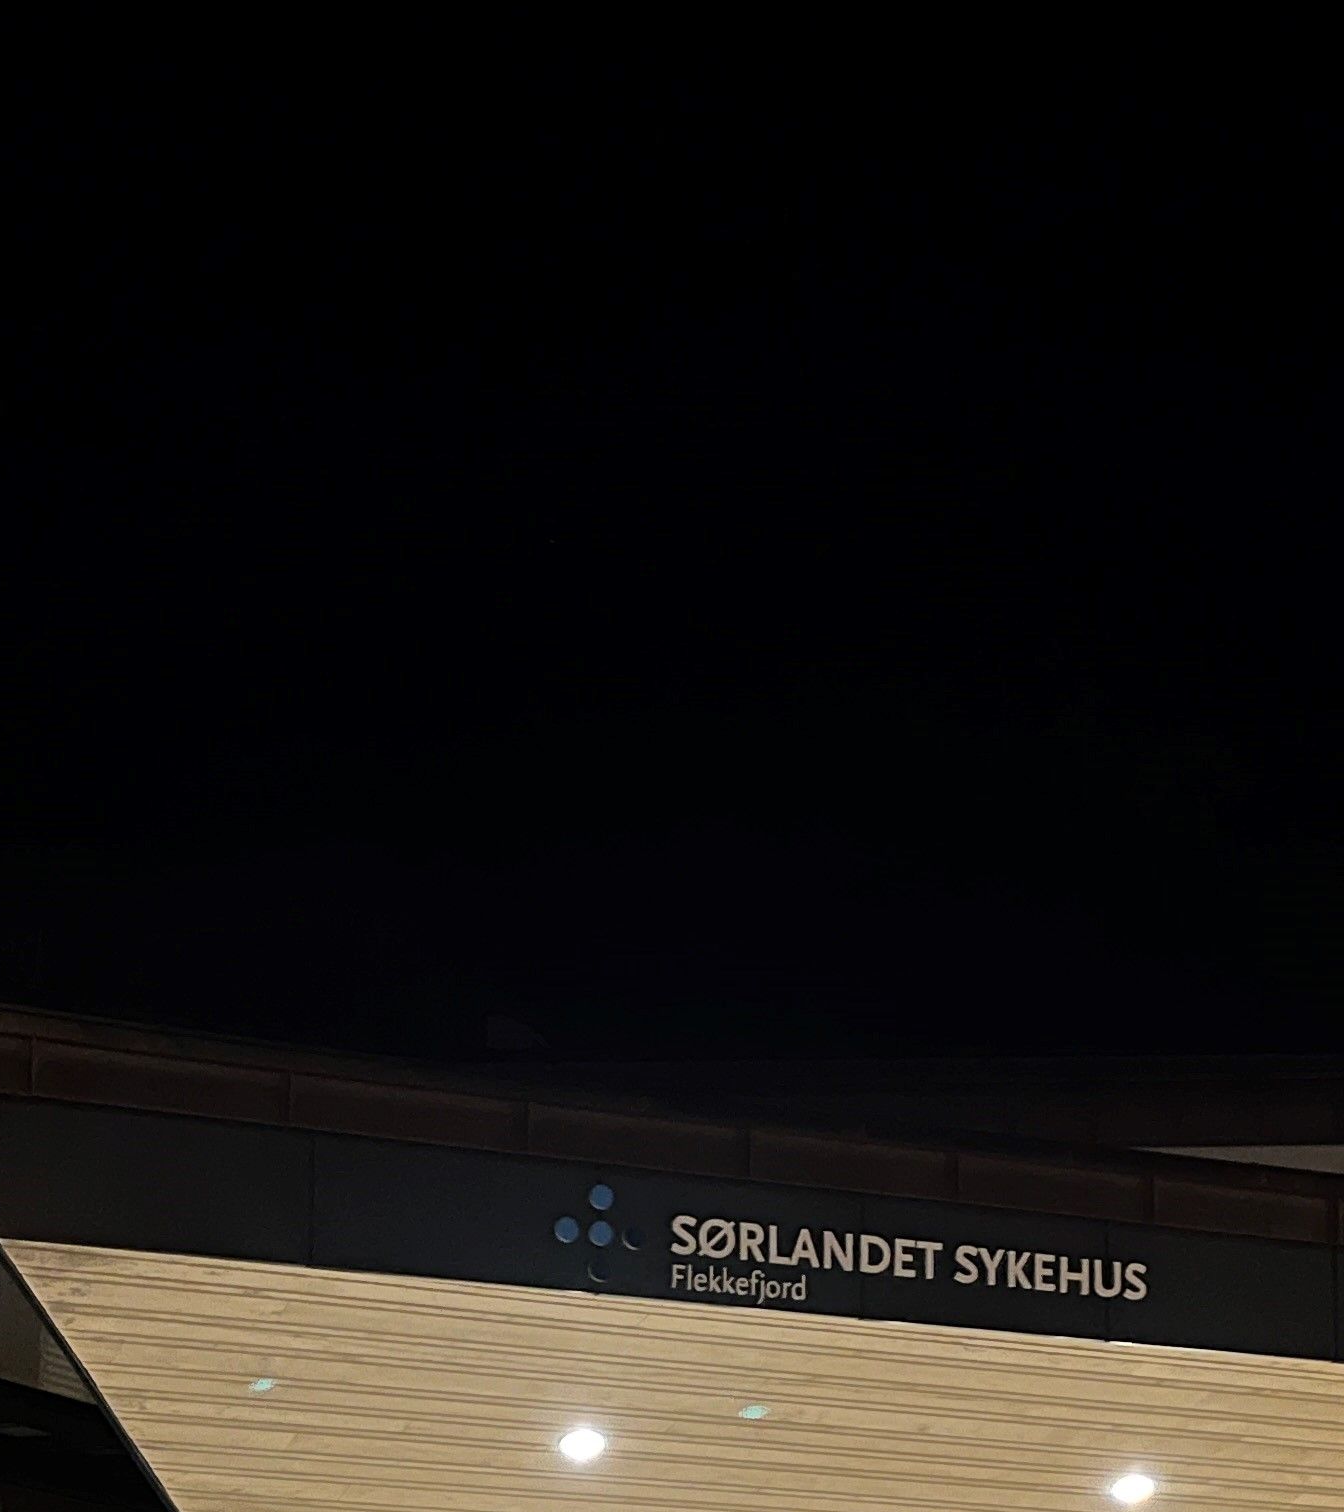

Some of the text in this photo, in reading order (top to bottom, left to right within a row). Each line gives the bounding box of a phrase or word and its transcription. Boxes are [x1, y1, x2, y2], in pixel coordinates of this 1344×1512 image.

[670, 1214, 1148, 1301] SØRLANDET SYKEHUS
[670, 1263, 807, 1305] Flekkefjord
